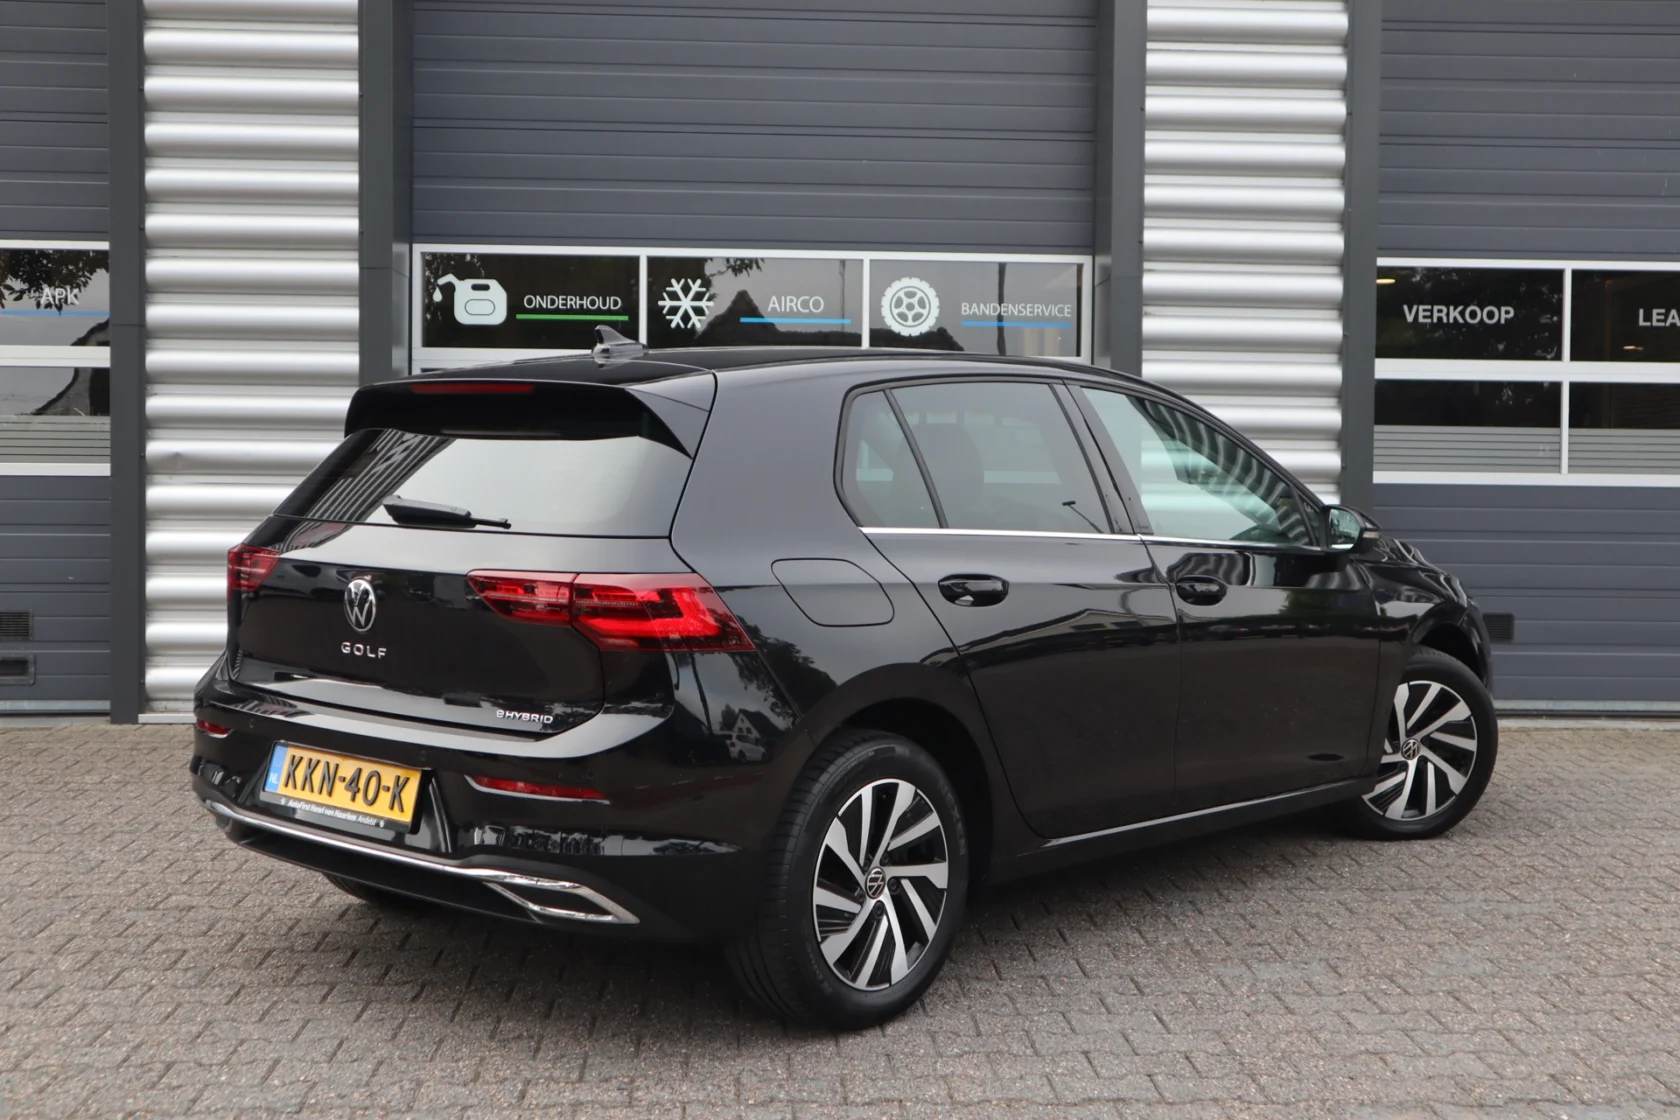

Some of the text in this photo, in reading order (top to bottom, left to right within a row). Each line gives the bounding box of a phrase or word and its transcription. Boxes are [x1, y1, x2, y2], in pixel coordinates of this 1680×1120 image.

[40, 287, 79, 305] APK
[523, 294, 622, 311] ONDERHOUD
[767, 295, 825, 313] AIRCO
[960, 302, 1072, 317] BANDENSERVICE
[1403, 304, 1515, 324] VERKOOP
[1638, 307, 1680, 327] LEA
[341, 641, 387, 659] GOLF
[269, 772, 279, 784] NL
[283, 754, 410, 813] KKN-40-K
